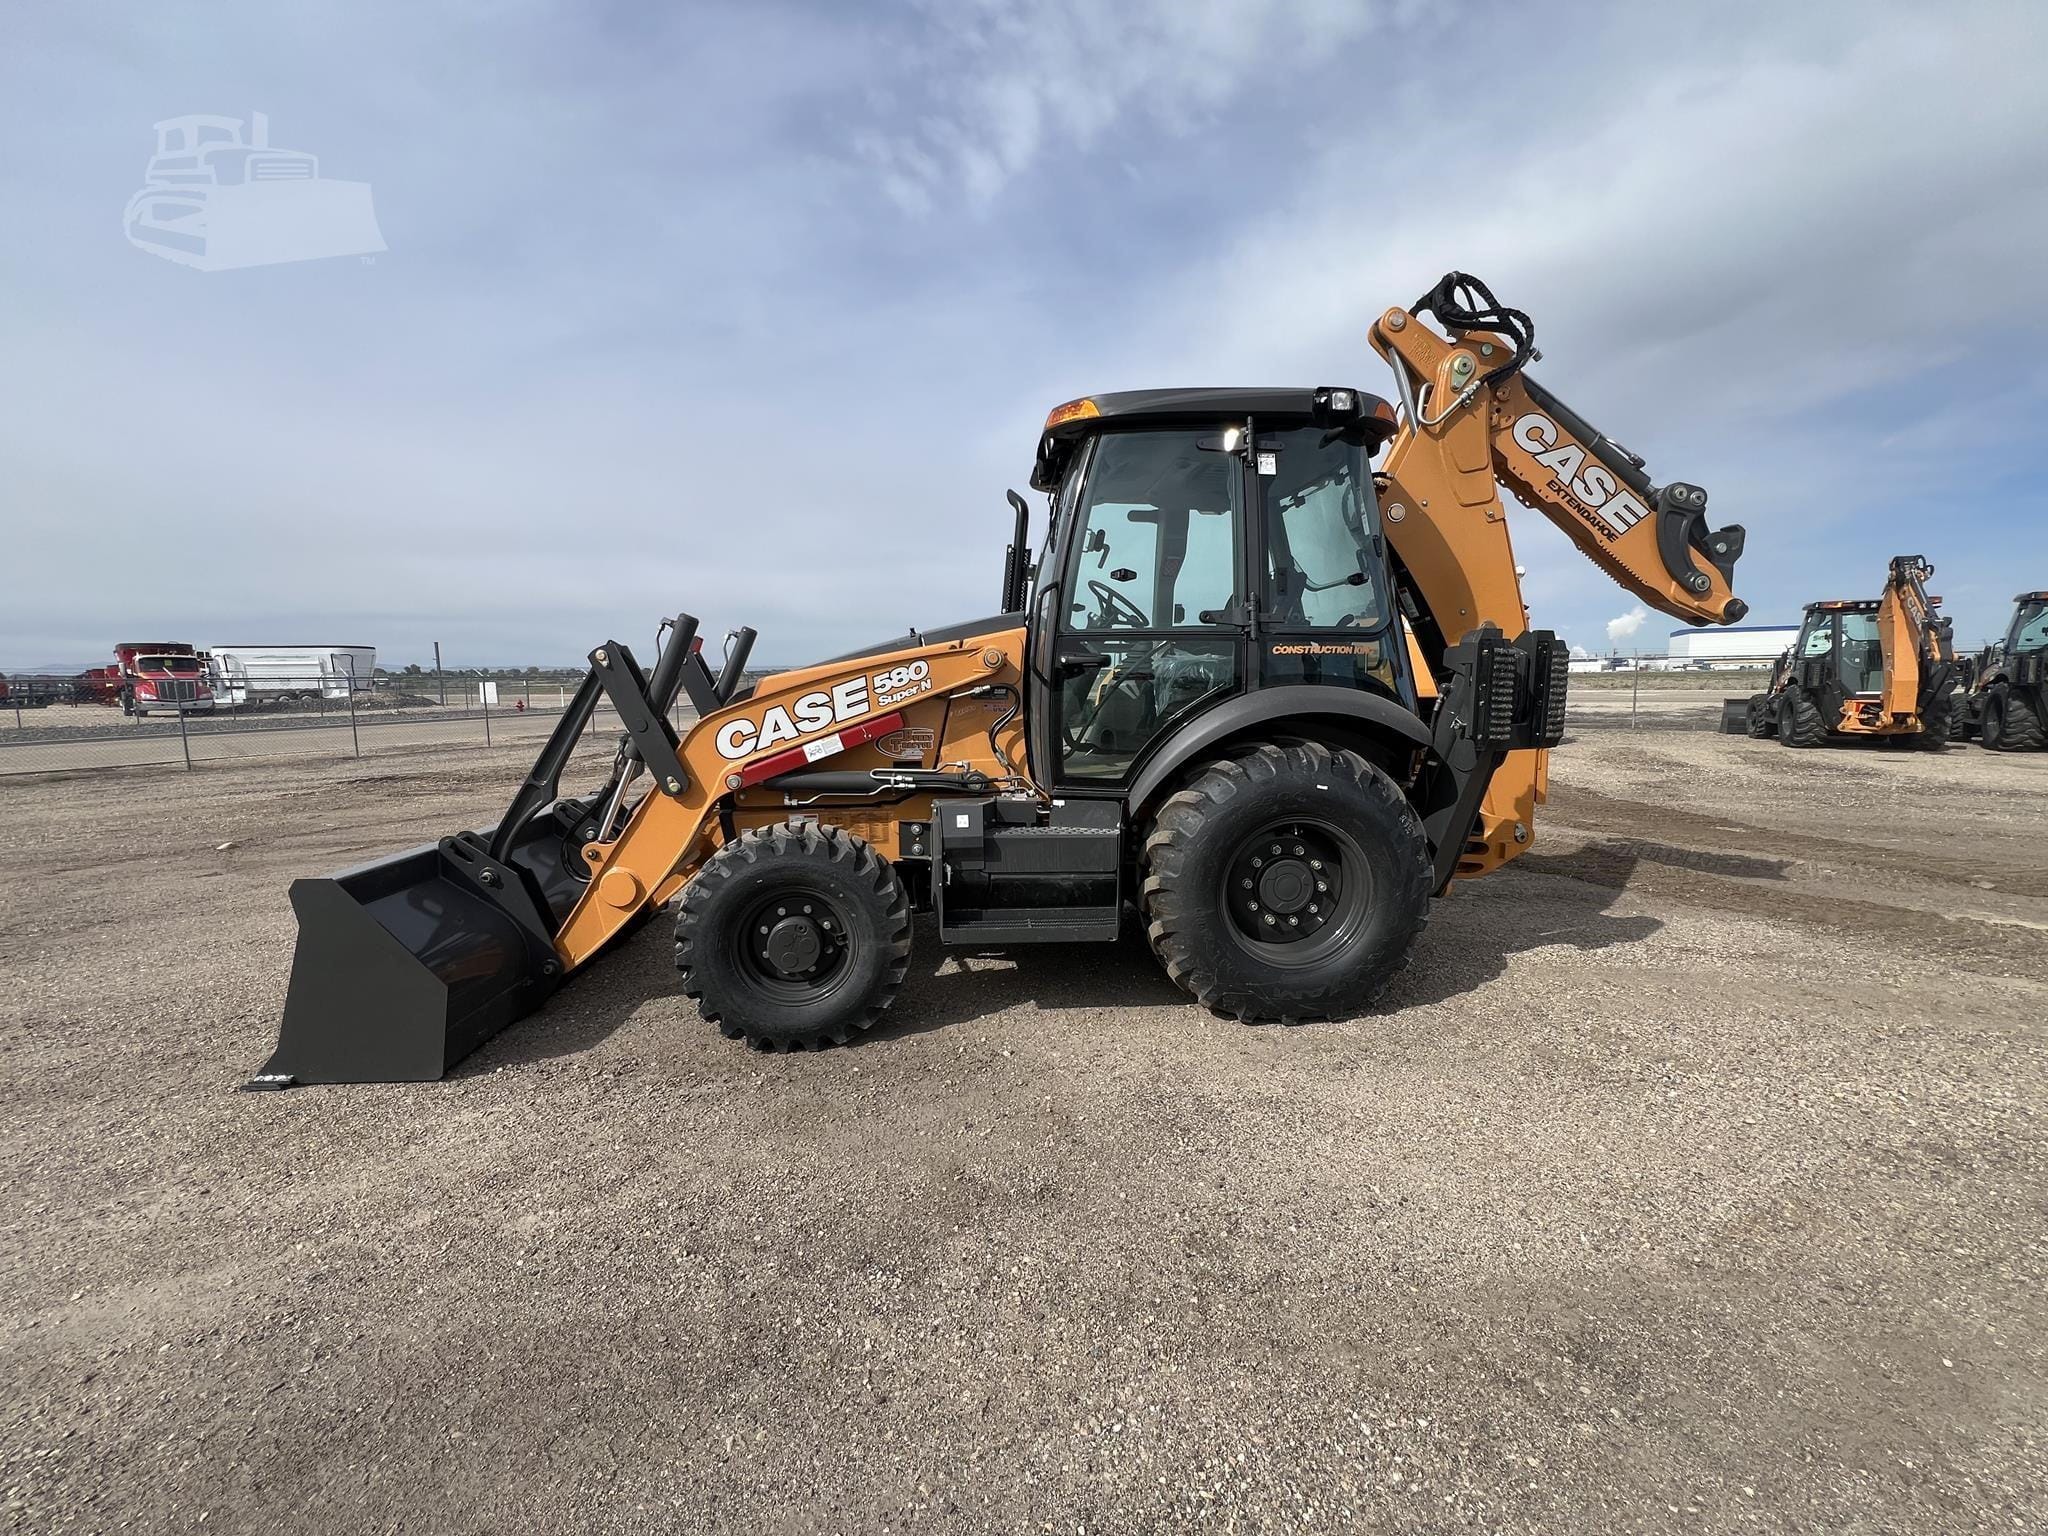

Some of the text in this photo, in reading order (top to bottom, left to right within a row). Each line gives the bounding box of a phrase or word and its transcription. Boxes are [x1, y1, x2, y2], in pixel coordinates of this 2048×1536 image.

[1512, 413, 1651, 535] CASE
[1546, 480, 1619, 543] EXTENDAHOE
[1272, 645, 1353, 655] CONSTRUCTION
[873, 660, 930, 694] 580
[878, 678, 932, 706] Super N
[715, 675, 870, 760] CASE
